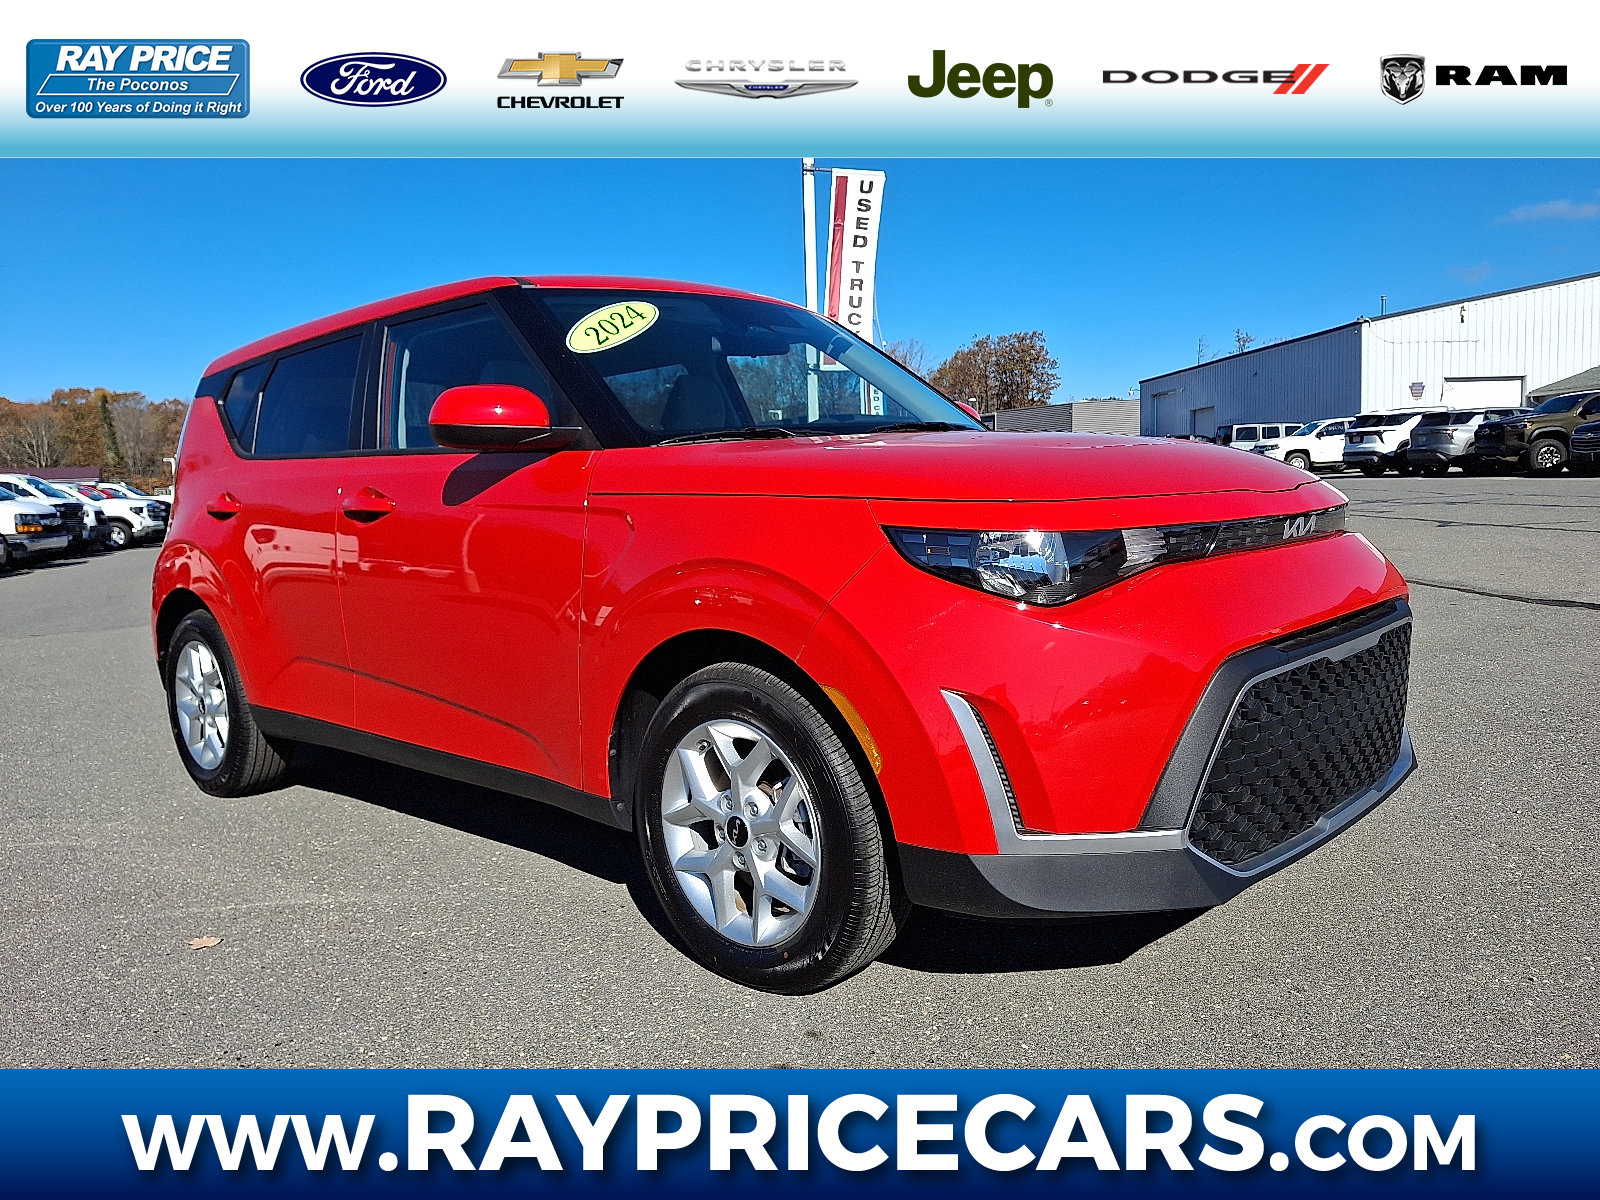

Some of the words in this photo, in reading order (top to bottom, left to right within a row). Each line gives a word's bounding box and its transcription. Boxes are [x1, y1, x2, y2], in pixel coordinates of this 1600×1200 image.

[852, 180, 874, 249] USED
[584, 305, 647, 346] 2024
[847, 260, 865, 336] TRUC
